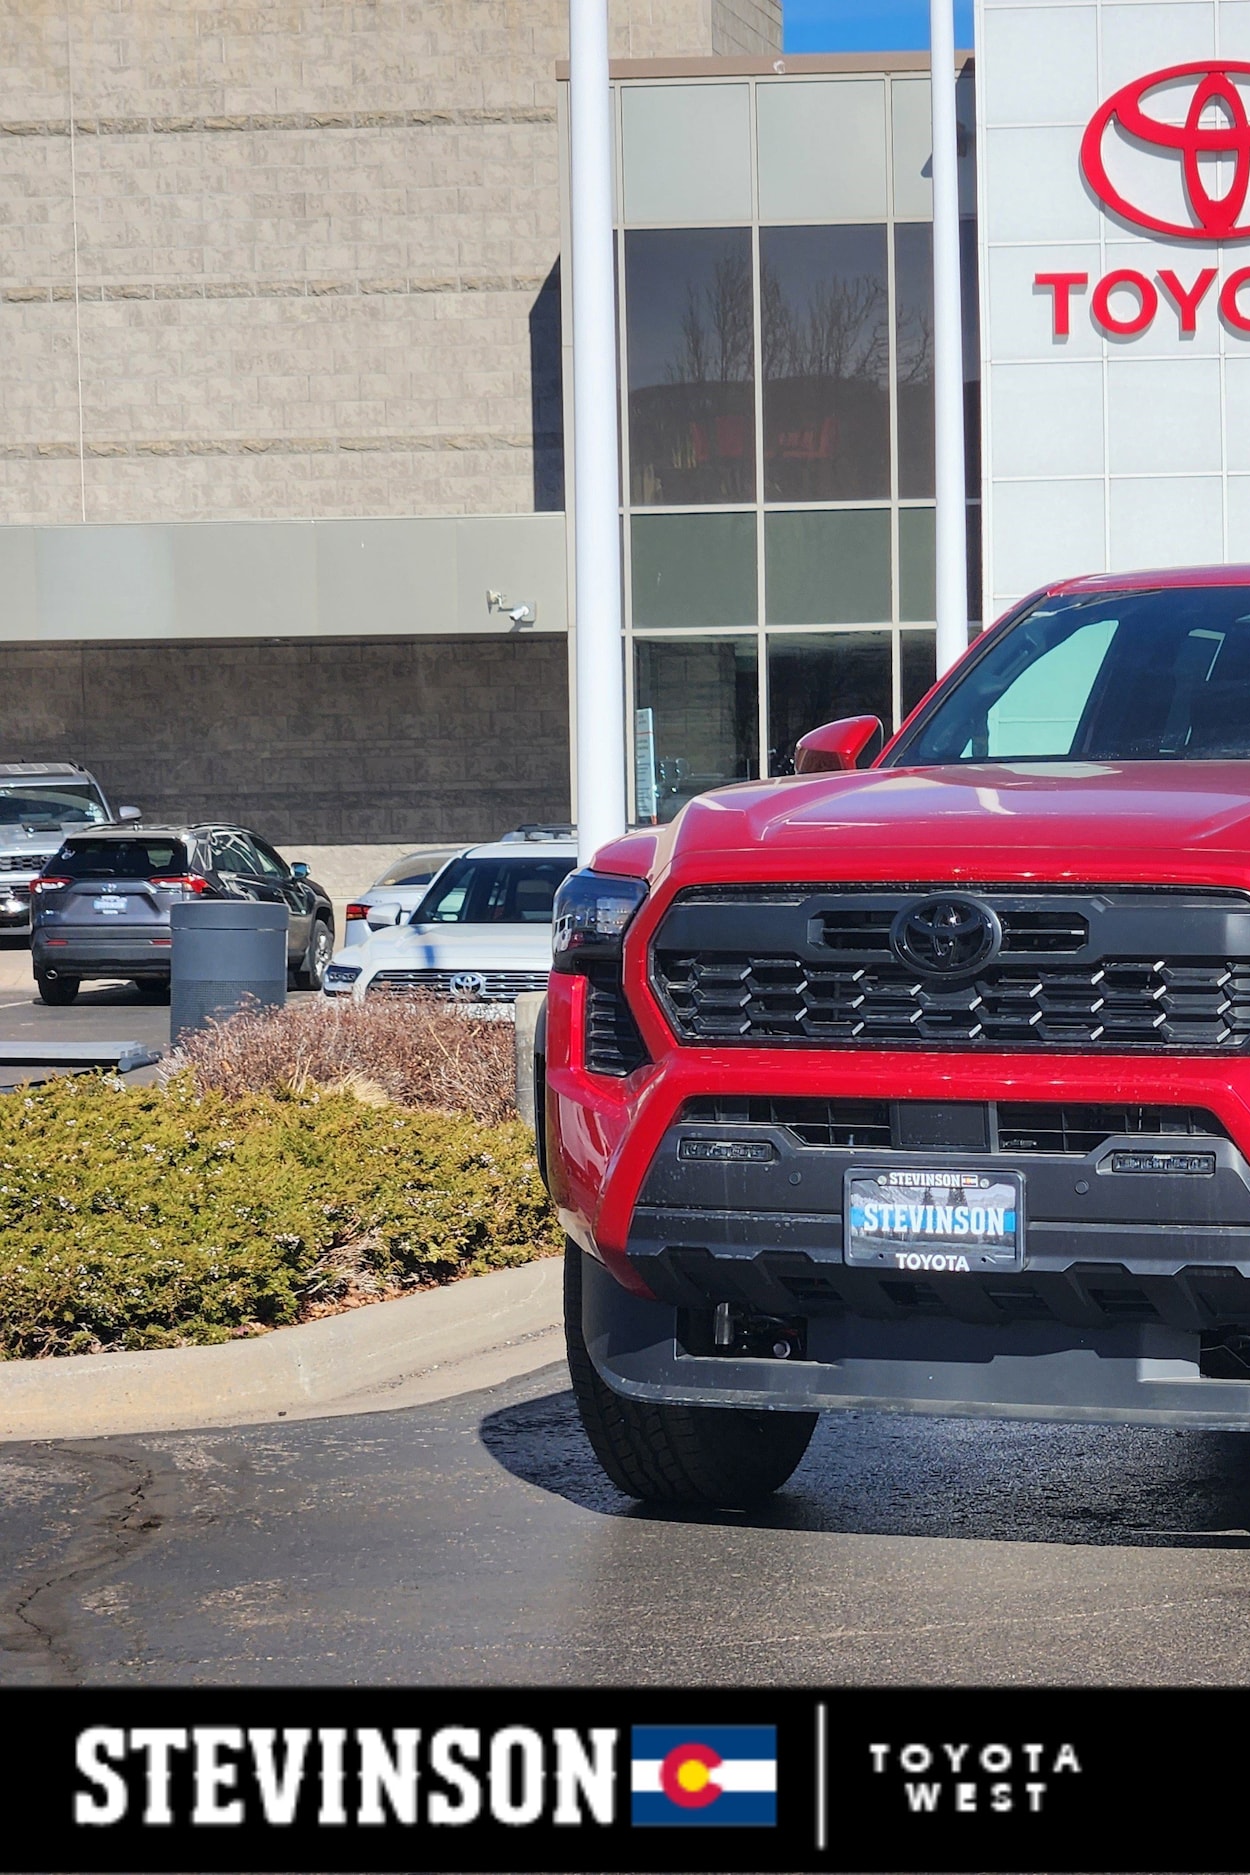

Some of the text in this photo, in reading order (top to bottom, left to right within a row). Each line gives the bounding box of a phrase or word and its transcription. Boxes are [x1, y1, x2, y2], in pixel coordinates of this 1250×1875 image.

[889, 1172, 961, 1188] STEVINSON
[863, 1203, 1005, 1236] STEVINSON
[895, 1253, 970, 1272] TOYOTA
